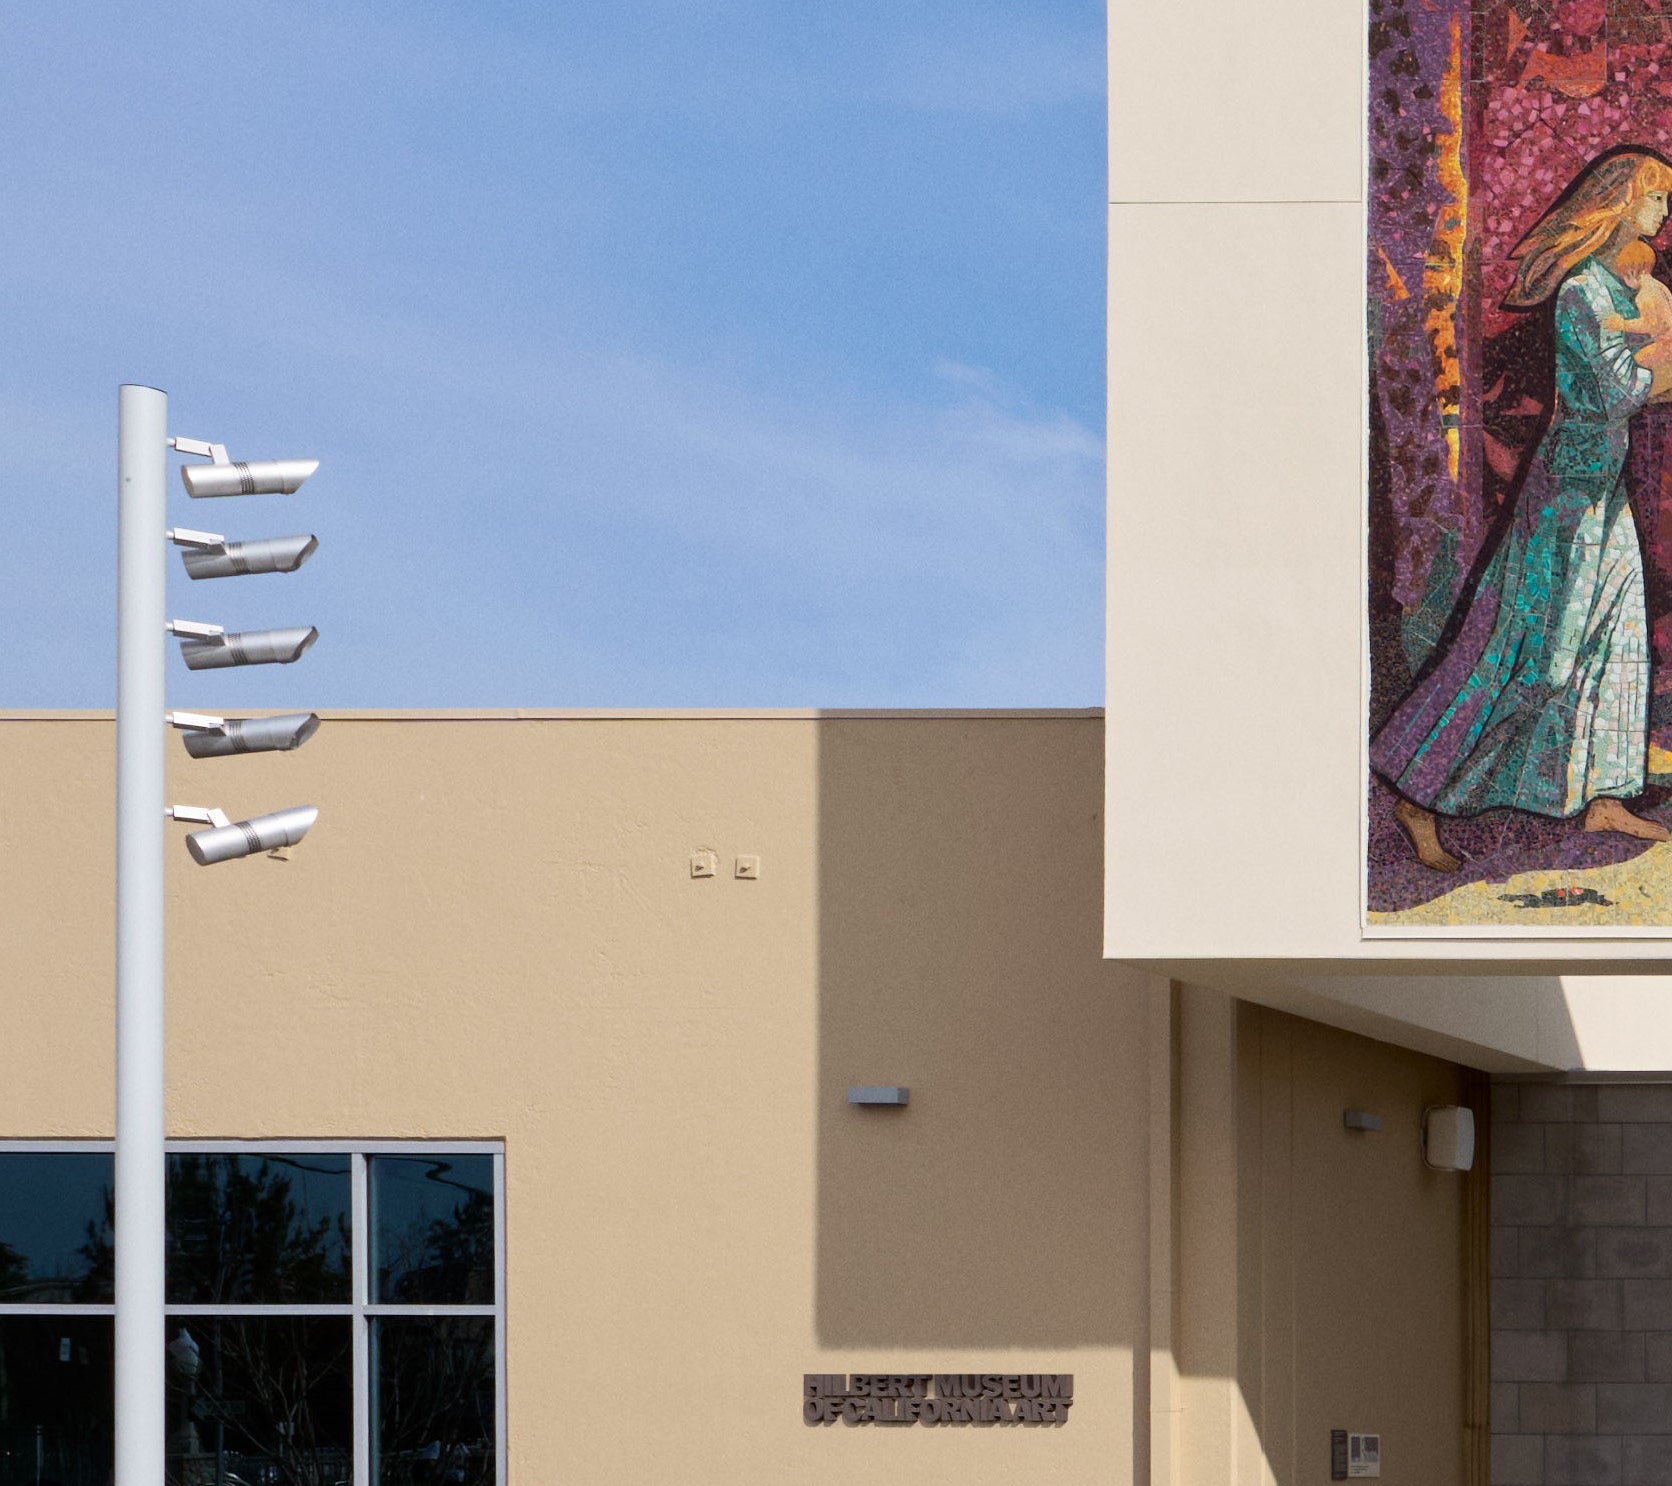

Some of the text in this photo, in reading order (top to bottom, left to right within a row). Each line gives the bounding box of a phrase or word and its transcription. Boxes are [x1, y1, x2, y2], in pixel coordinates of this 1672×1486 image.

[803, 1374, 1073, 1398] HILBERT MUSEUM
[803, 1398, 1072, 1423] OF CALIFORNIA ART
